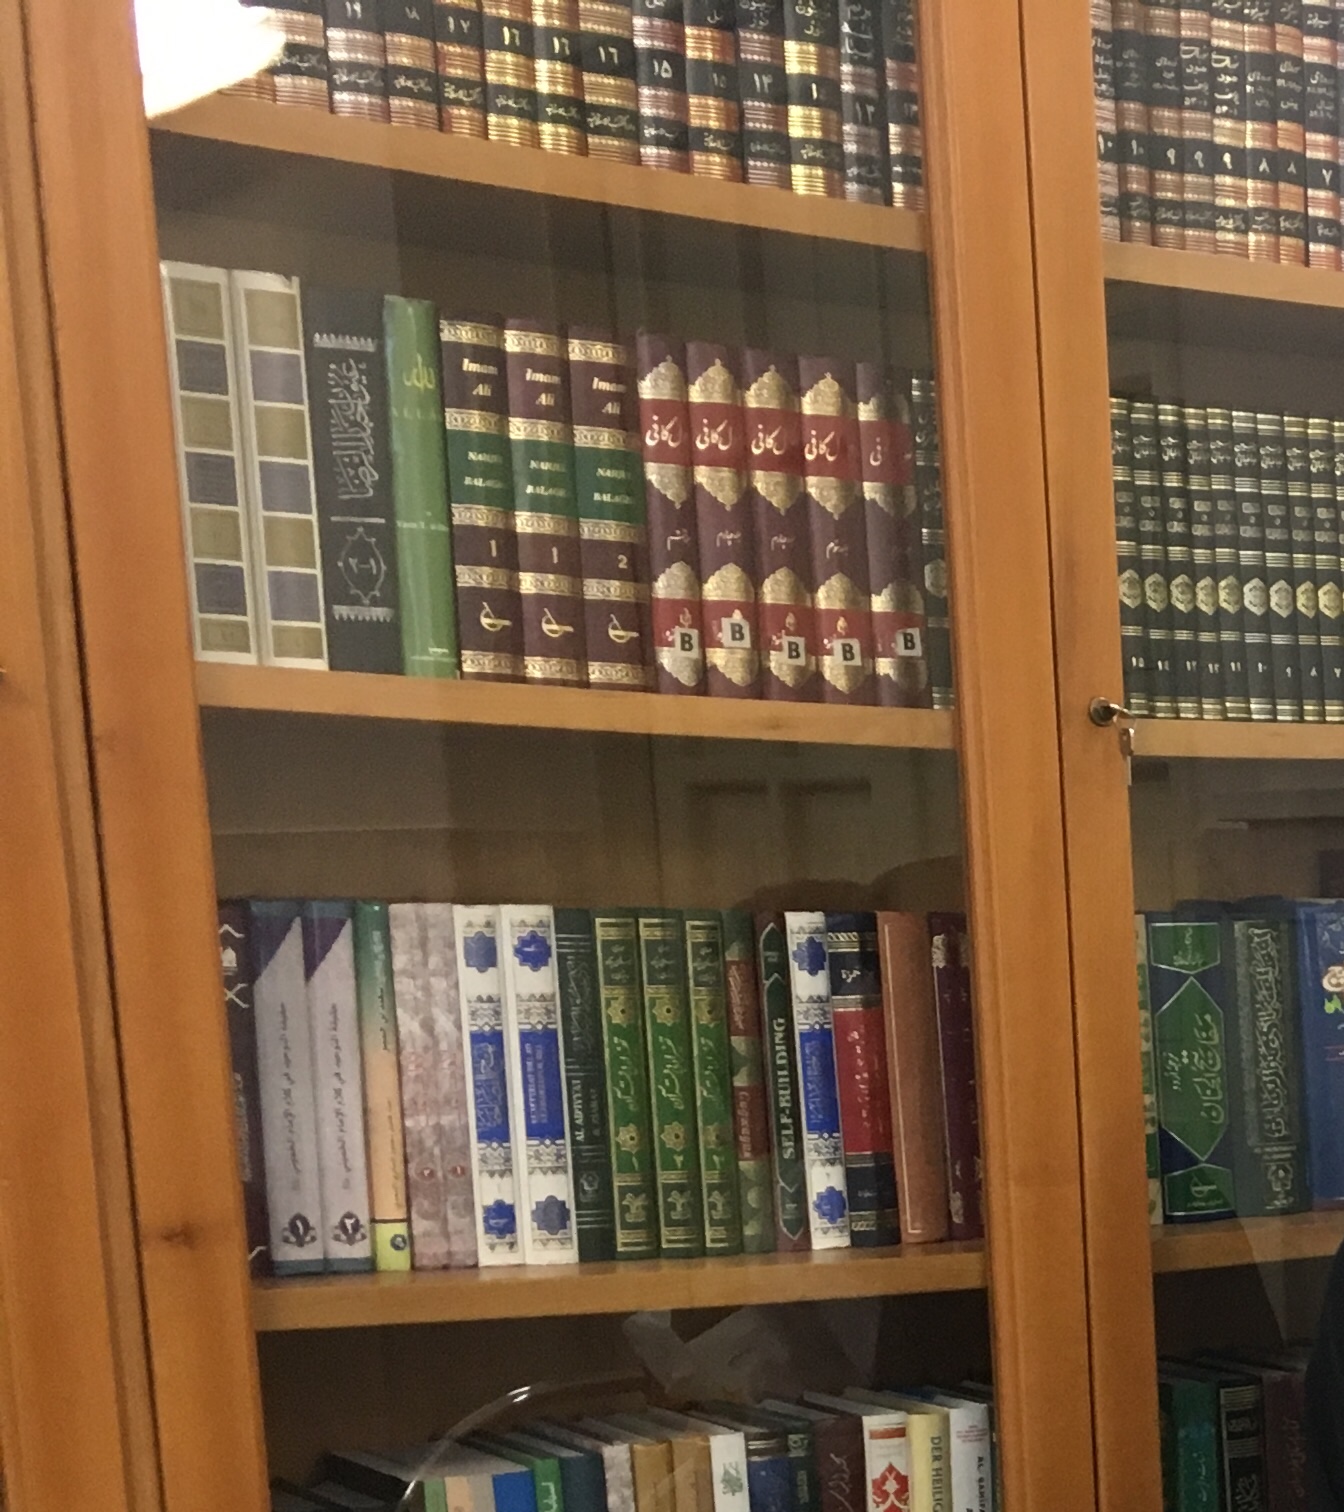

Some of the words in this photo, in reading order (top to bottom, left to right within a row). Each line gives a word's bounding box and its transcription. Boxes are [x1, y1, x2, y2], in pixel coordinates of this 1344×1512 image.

[462, 358, 499, 376] Imam
[525, 368, 561, 386] Imam
[592, 377, 627, 394] Imam
[473, 383, 492, 398] Ali
[535, 393, 555, 407] Ali
[602, 401, 621, 416] Ali
[730, 623, 744, 642] B
[902, 631, 916, 651] B
[680, 634, 694, 653] B
[787, 640, 801, 660] B
[842, 643, 855, 662] B
[773, 1017, 796, 1161] SELF-BUILDING
[930, 1436, 944, 1462] DER
